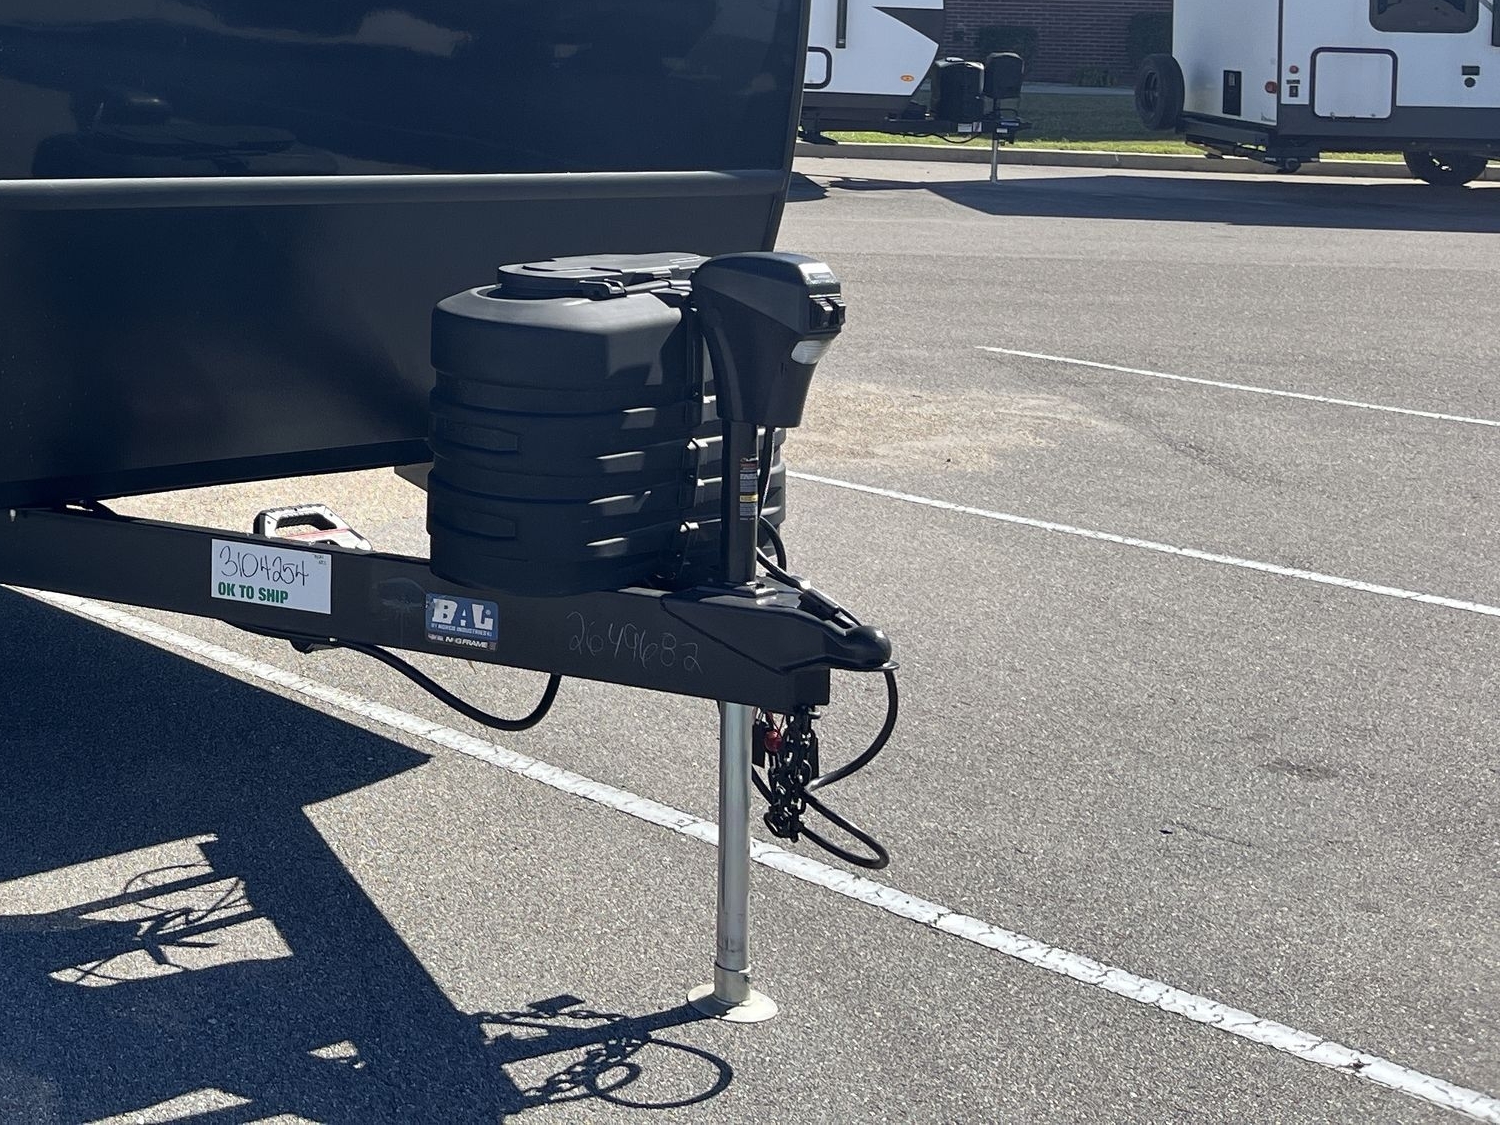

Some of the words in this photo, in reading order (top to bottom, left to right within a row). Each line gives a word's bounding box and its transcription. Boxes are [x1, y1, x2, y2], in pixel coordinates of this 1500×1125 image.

[219, 545, 309, 587] 3104254
[217, 581, 236, 597] OK
[238, 584, 255, 600] TO
[258, 587, 289, 604] SHIP
